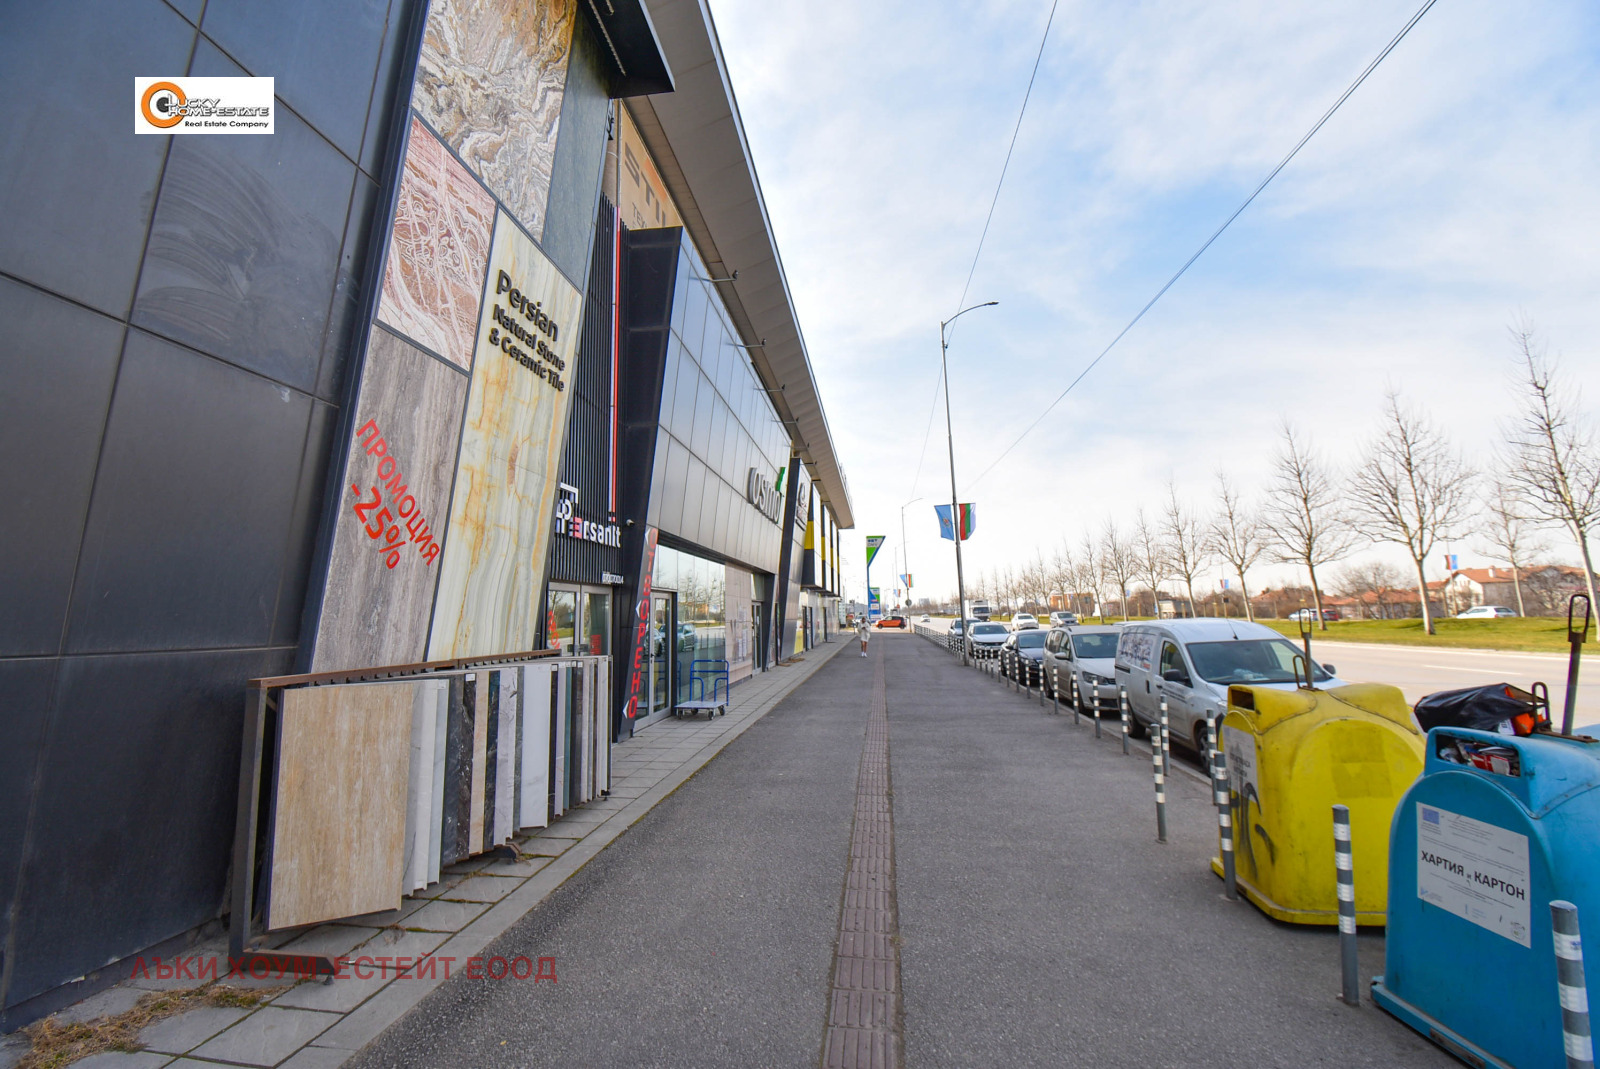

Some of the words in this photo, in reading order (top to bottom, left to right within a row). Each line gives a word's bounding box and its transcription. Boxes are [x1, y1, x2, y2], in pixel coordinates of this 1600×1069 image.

[492, 303, 537, 350] Natural
[536, 339, 566, 372] Stone
[496, 269, 559, 342] Persian
[489, 327, 500, 347] &
[501, 336, 547, 380] Ceramic
[547, 367, 565, 392] Tile
[351, 483, 406, 569] -25%
[356, 418, 441, 566] ПРОМОЦИЯ
[628, 528, 659, 719] ОТВОРЕНО
[1421, 850, 1464, 876] ХАРТИЯ
[1474, 871, 1525, 900] КАРТОН
